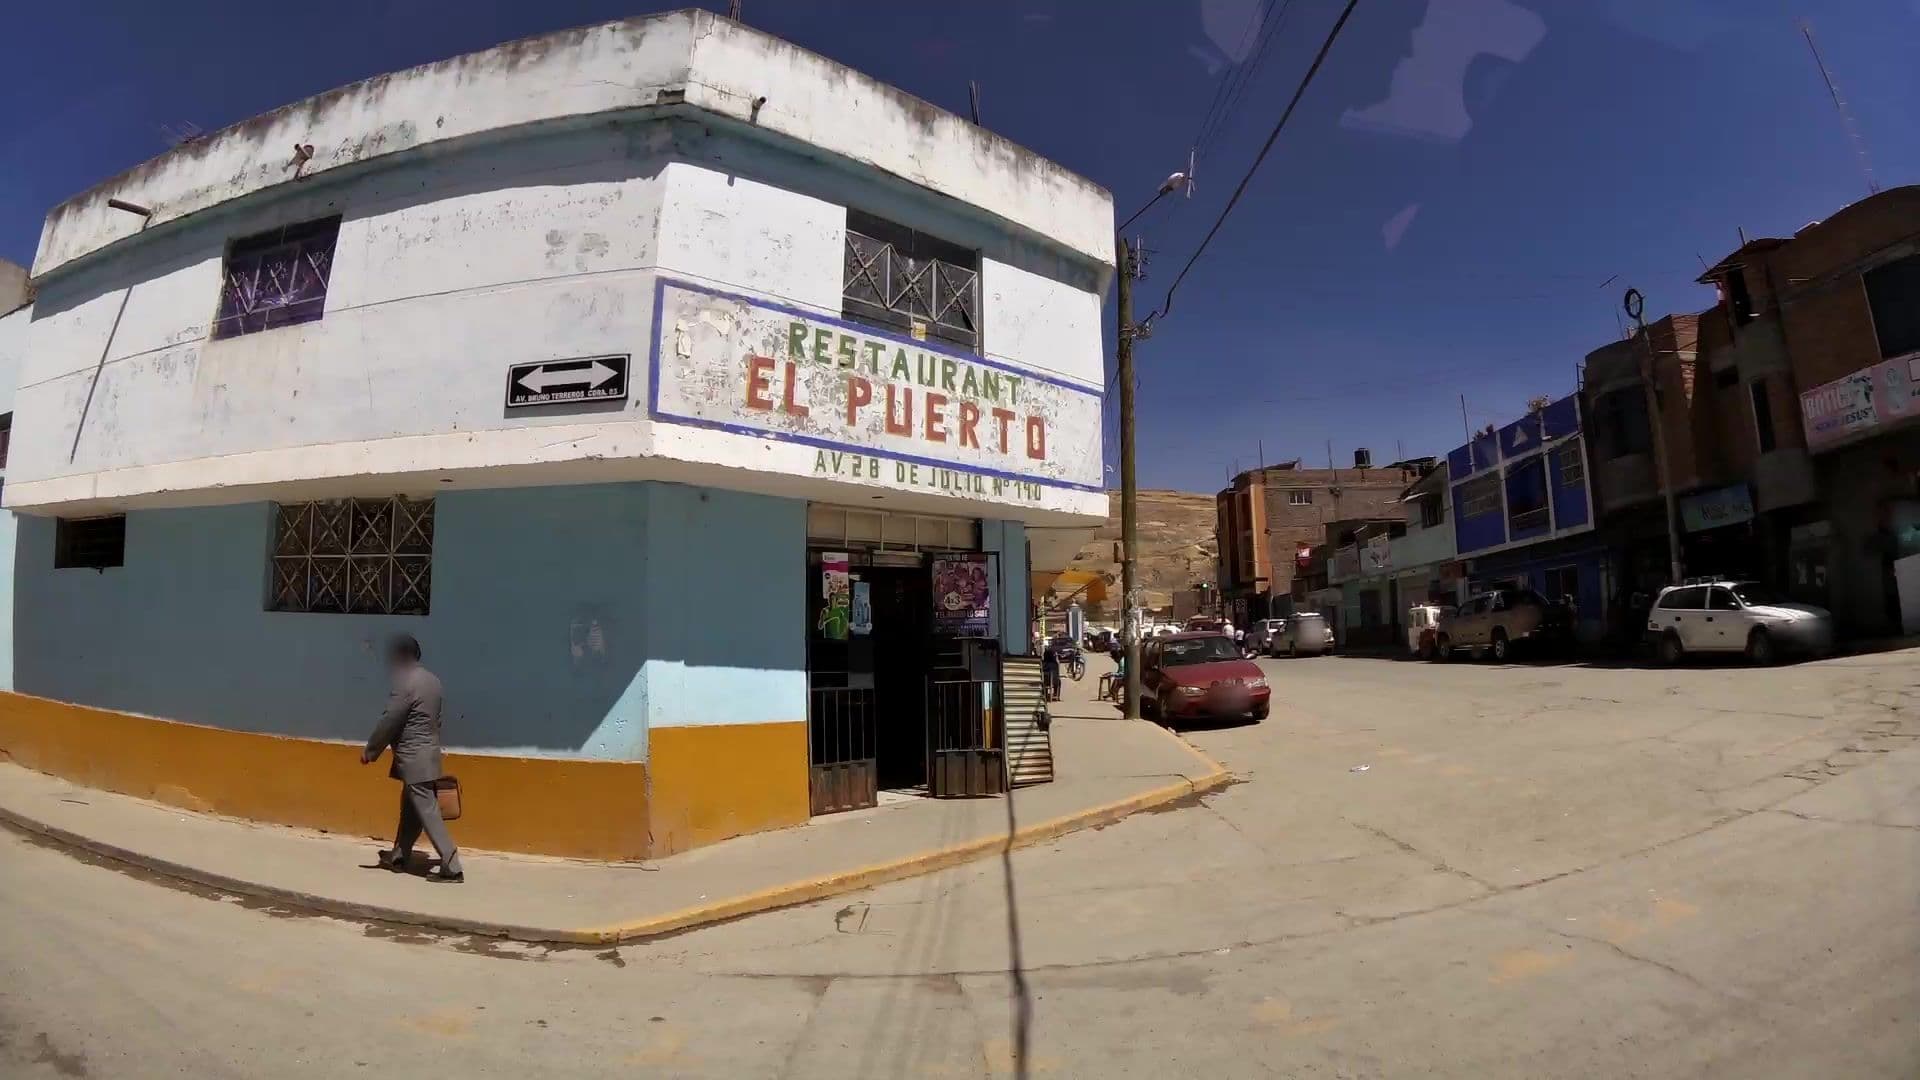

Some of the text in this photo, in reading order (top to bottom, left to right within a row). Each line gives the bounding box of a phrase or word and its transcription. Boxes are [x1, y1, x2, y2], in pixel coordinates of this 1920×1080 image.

[788, 322, 1022, 405] RESTAURANT
[515, 394, 527, 402] AV.
[528, 393, 550, 402] BRUNO
[551, 391, 584, 400] TERREROS
[746, 356, 1046, 460] EL PUERTO
[896, 461, 919, 485] DE
[928, 468, 982, 493] JULIO
